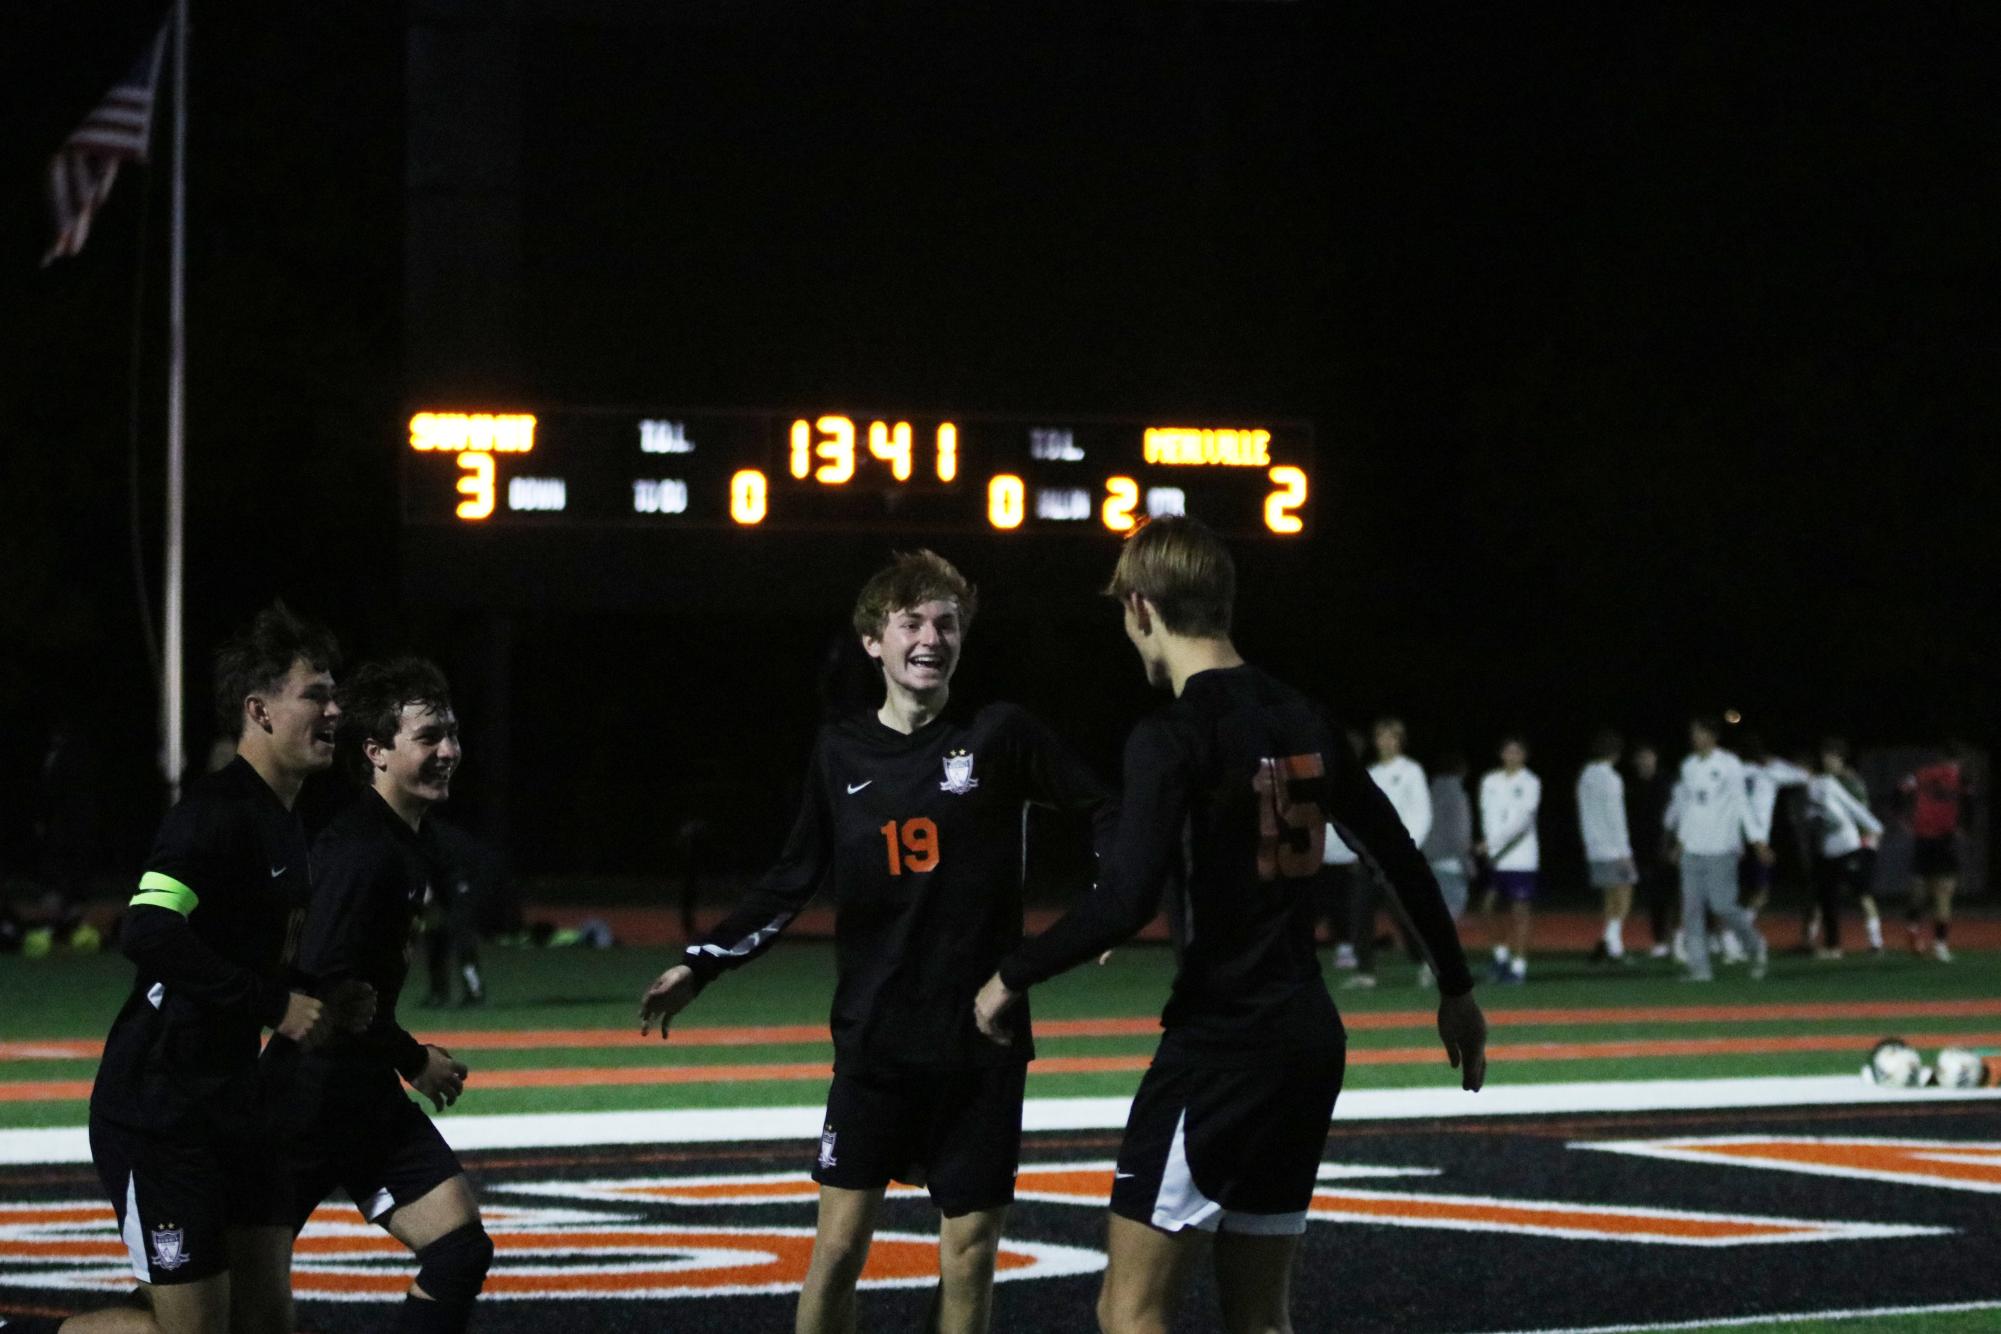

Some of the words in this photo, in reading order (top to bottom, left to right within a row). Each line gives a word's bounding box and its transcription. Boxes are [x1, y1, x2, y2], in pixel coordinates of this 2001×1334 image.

[455, 453, 498, 521] 3
[729, 468, 768, 526] 0
[987, 473, 1026, 530] 0
[1101, 475, 1139, 532] 2
[1263, 464, 1309, 534] 2
[880, 816, 941, 877] 19
[1251, 753, 1326, 881] 15
